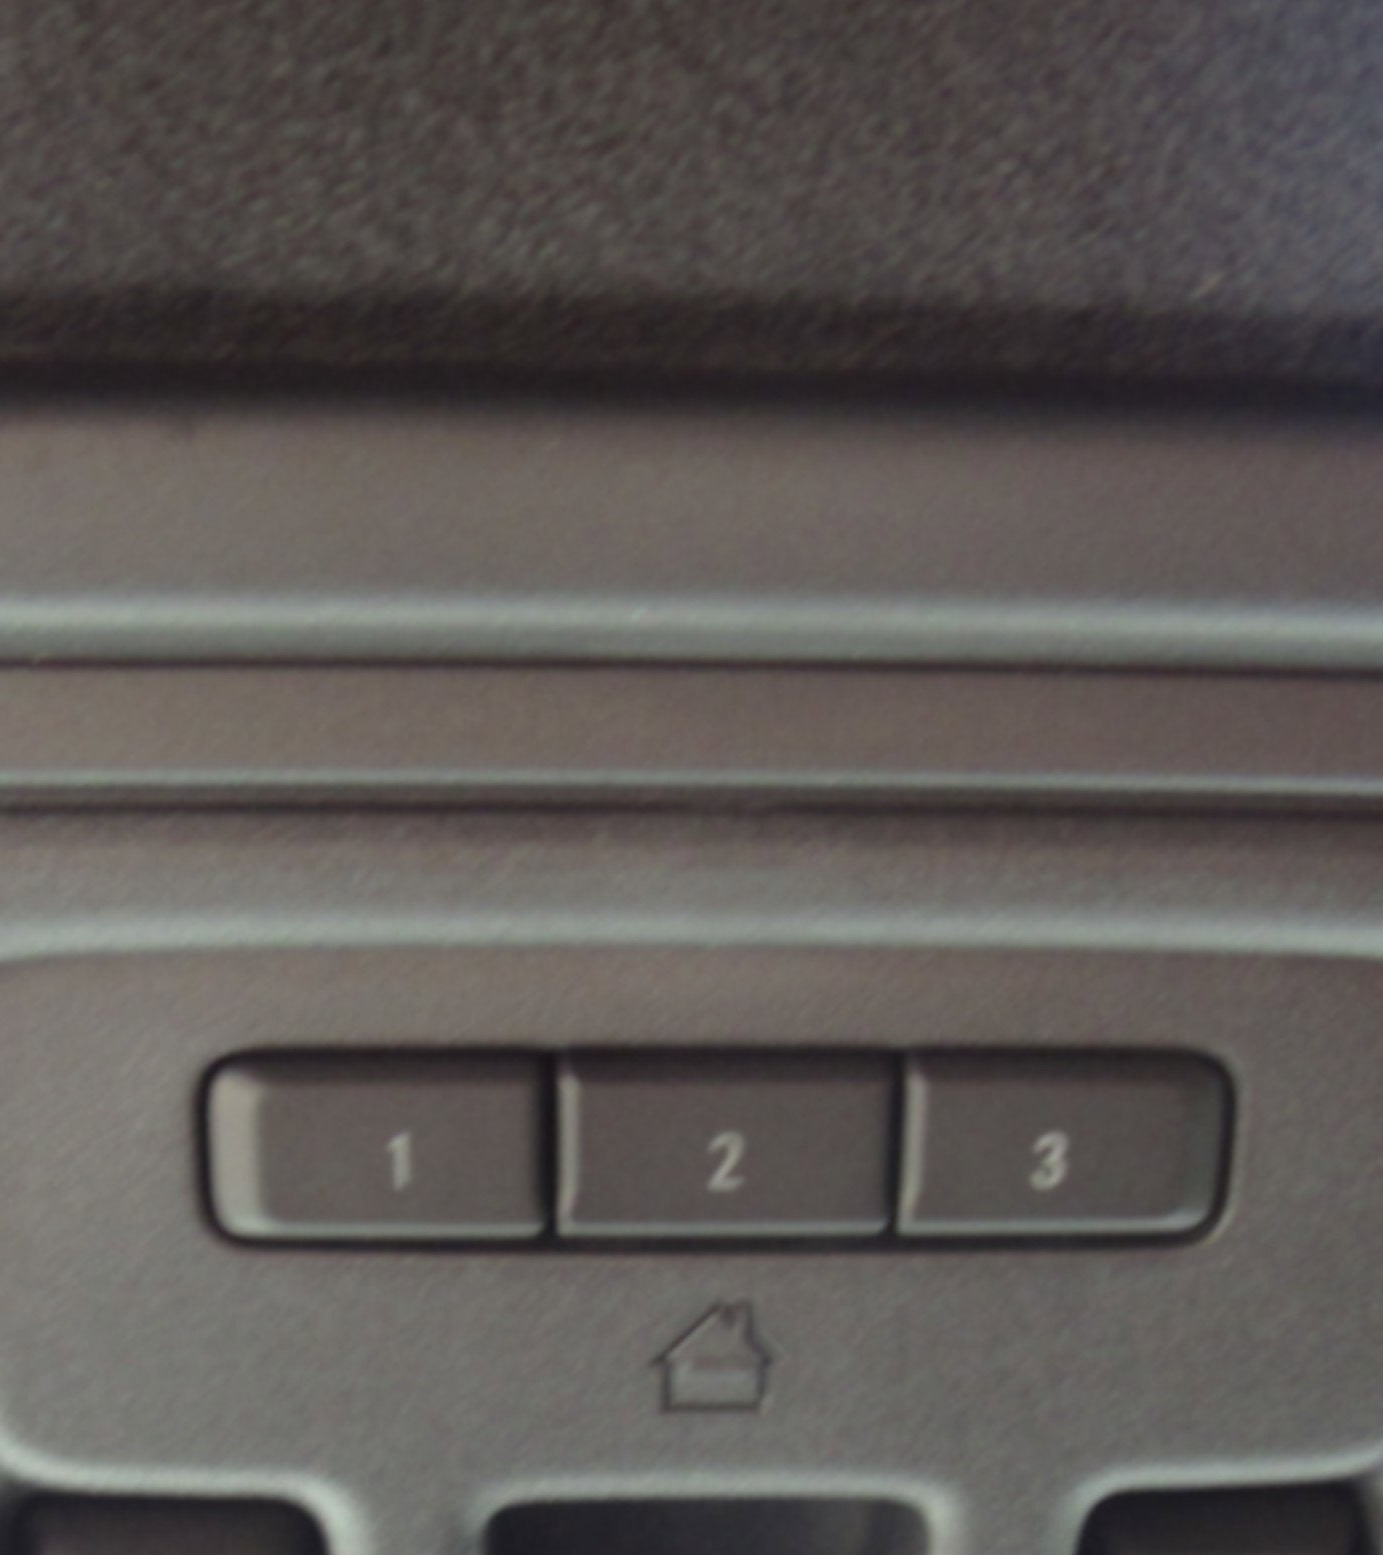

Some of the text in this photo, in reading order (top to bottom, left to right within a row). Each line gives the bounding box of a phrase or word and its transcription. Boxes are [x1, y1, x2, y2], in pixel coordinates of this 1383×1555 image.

[384, 1132, 414, 1189] 1
[706, 1132, 746, 1191] 2
[1029, 1131, 1071, 1189] 3
